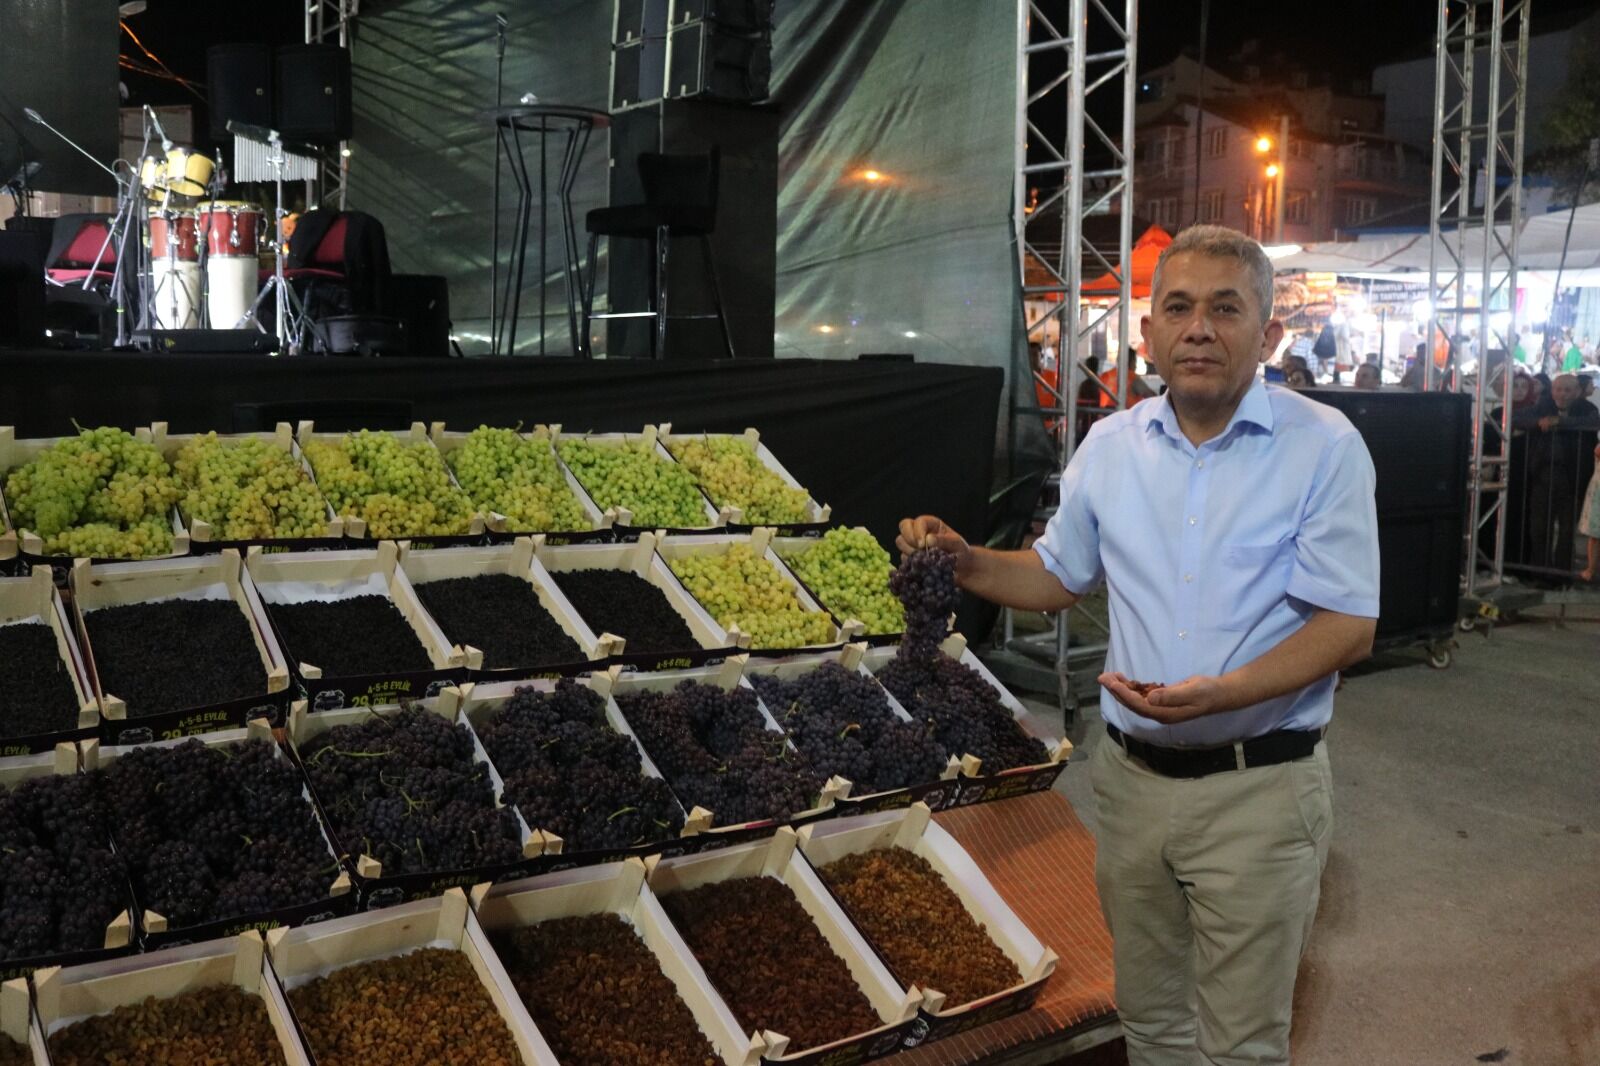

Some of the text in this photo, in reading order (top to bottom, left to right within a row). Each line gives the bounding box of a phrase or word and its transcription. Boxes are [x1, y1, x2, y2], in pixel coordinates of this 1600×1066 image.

[367, 680, 411, 694] 4-5-6 EYLÜL
[203, 710, 227, 722] EYLÜL
